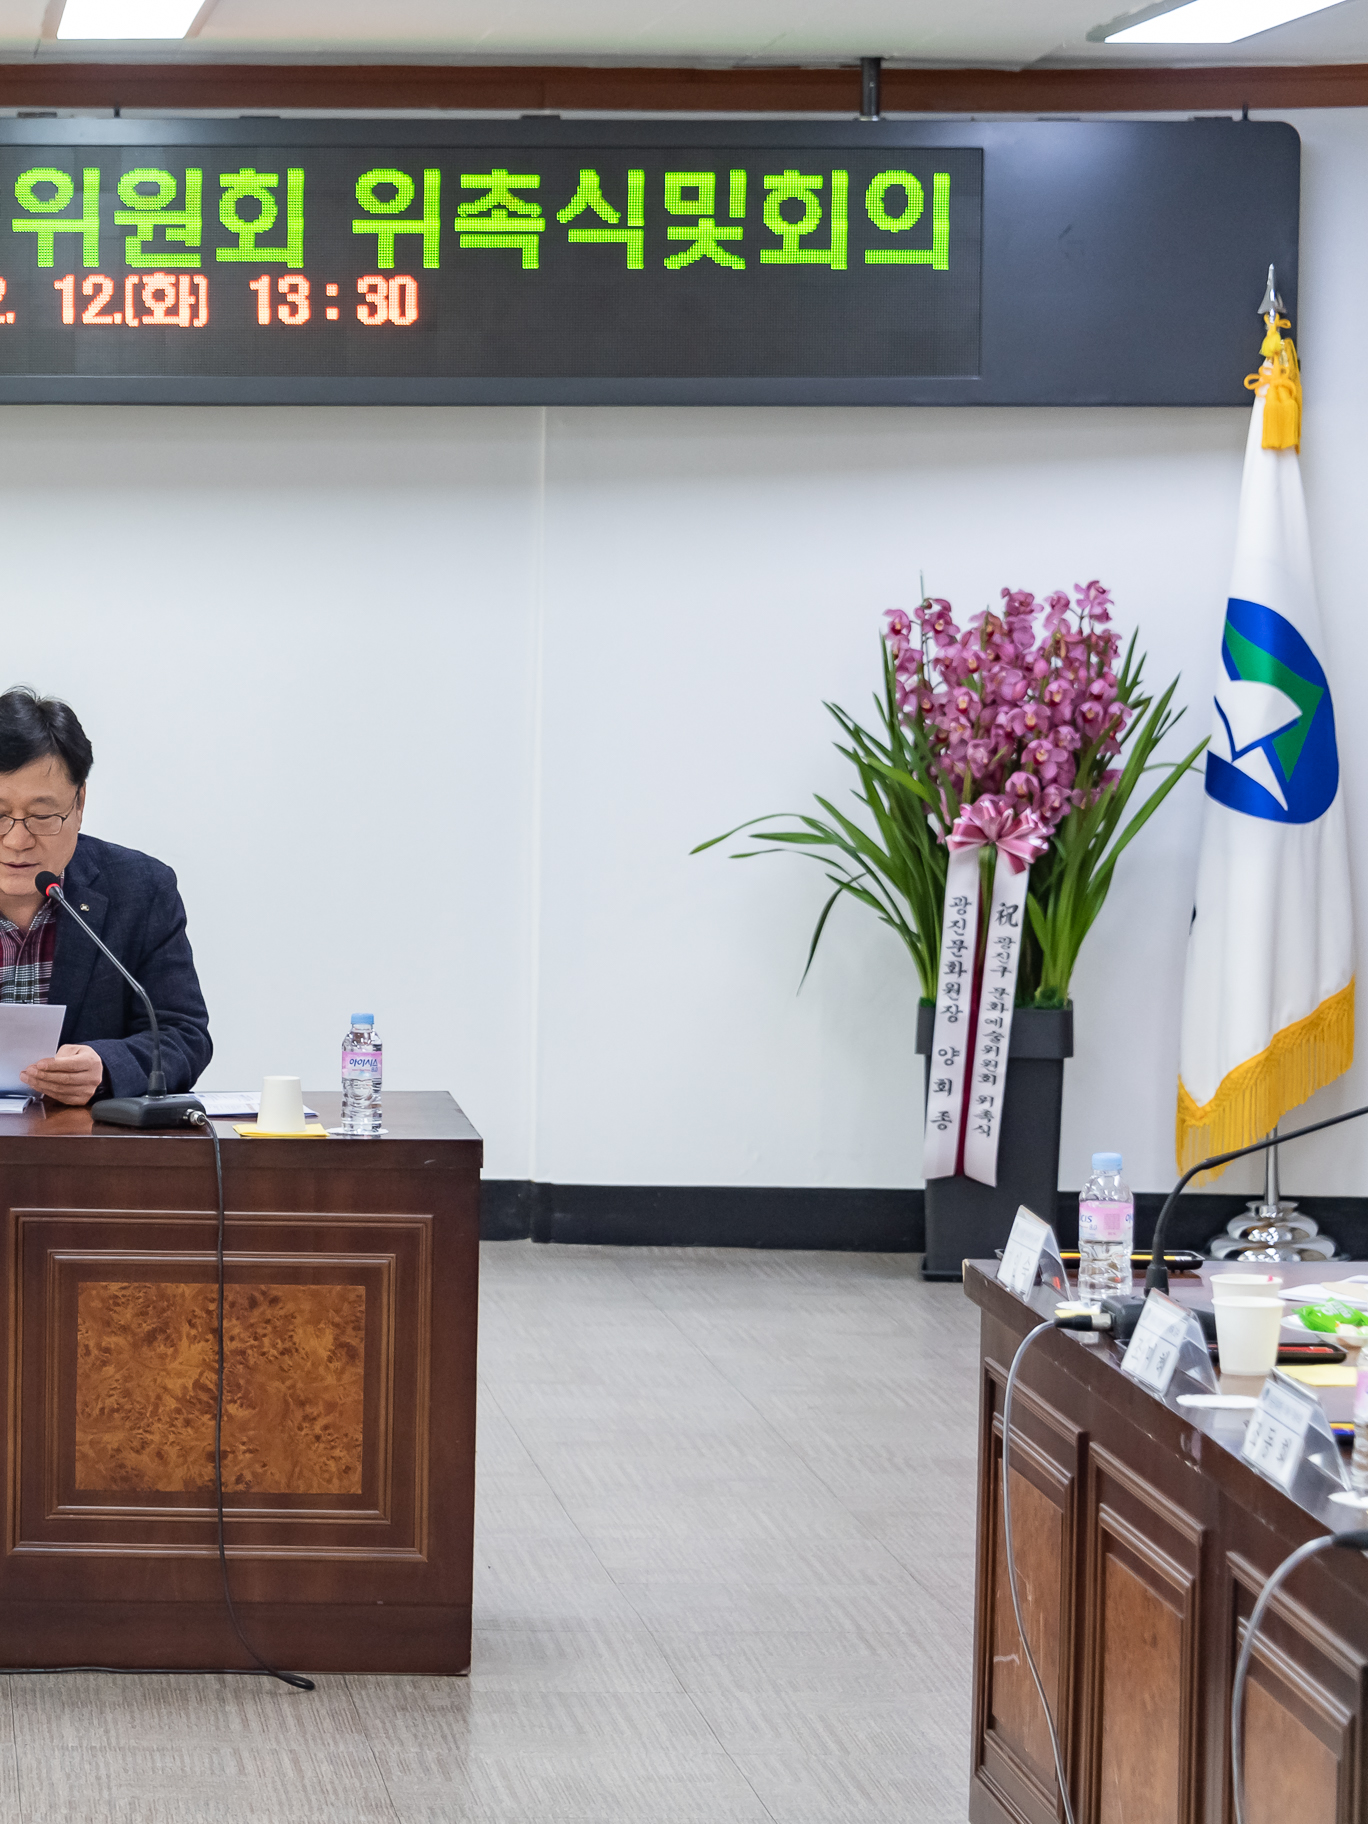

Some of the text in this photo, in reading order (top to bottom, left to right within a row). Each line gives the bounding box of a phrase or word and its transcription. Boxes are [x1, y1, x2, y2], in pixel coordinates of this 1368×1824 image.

[351, 168, 951, 271] 위촉식및회의
[995, 902, 1020, 928] 祝
[940, 895, 972, 1024] 광진문화원장
[989, 936, 1016, 978] 광진구
